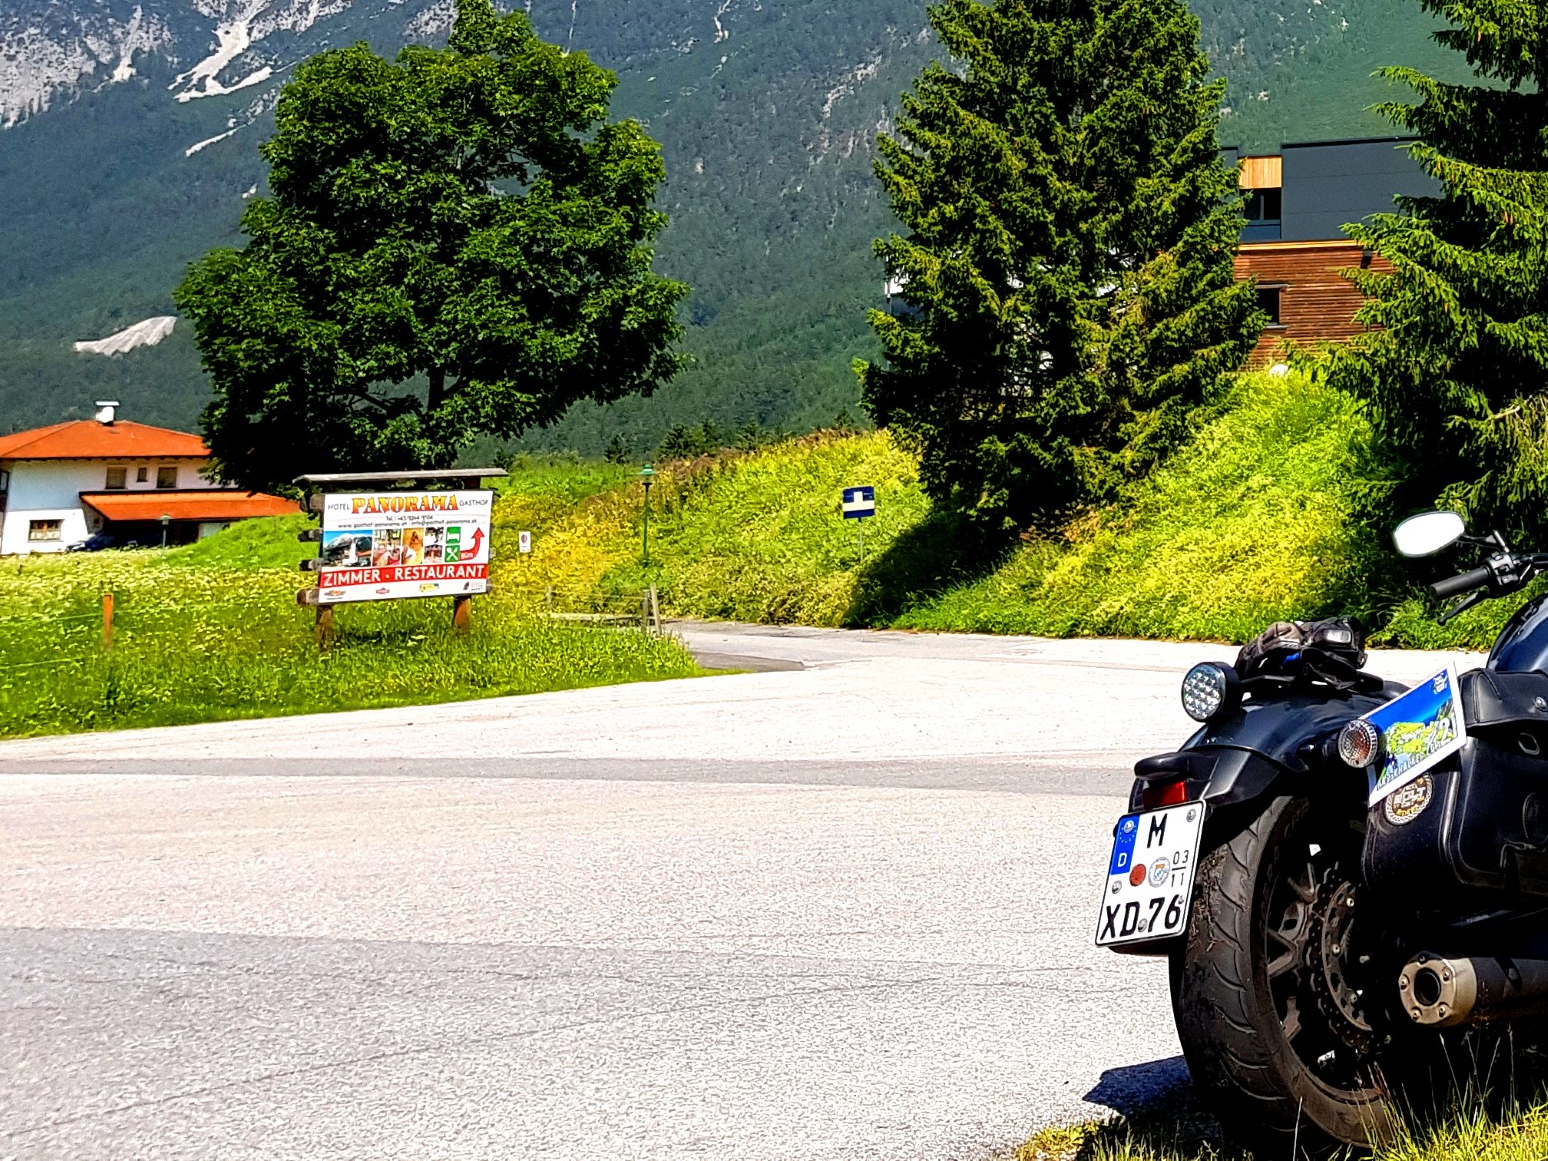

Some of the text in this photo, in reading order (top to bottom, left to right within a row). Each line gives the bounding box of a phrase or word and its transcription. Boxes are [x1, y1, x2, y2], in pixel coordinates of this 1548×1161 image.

[352, 495, 459, 514] PANORAMA
[459, 499, 489, 507] GASTHOF
[323, 565, 484, 587] ZIMMER RESTAURANT
[1147, 813, 1168, 849] M
[1117, 852, 1128, 868] D
[1172, 849, 1190, 865] 03
[1171, 872, 1185, 888] 11
